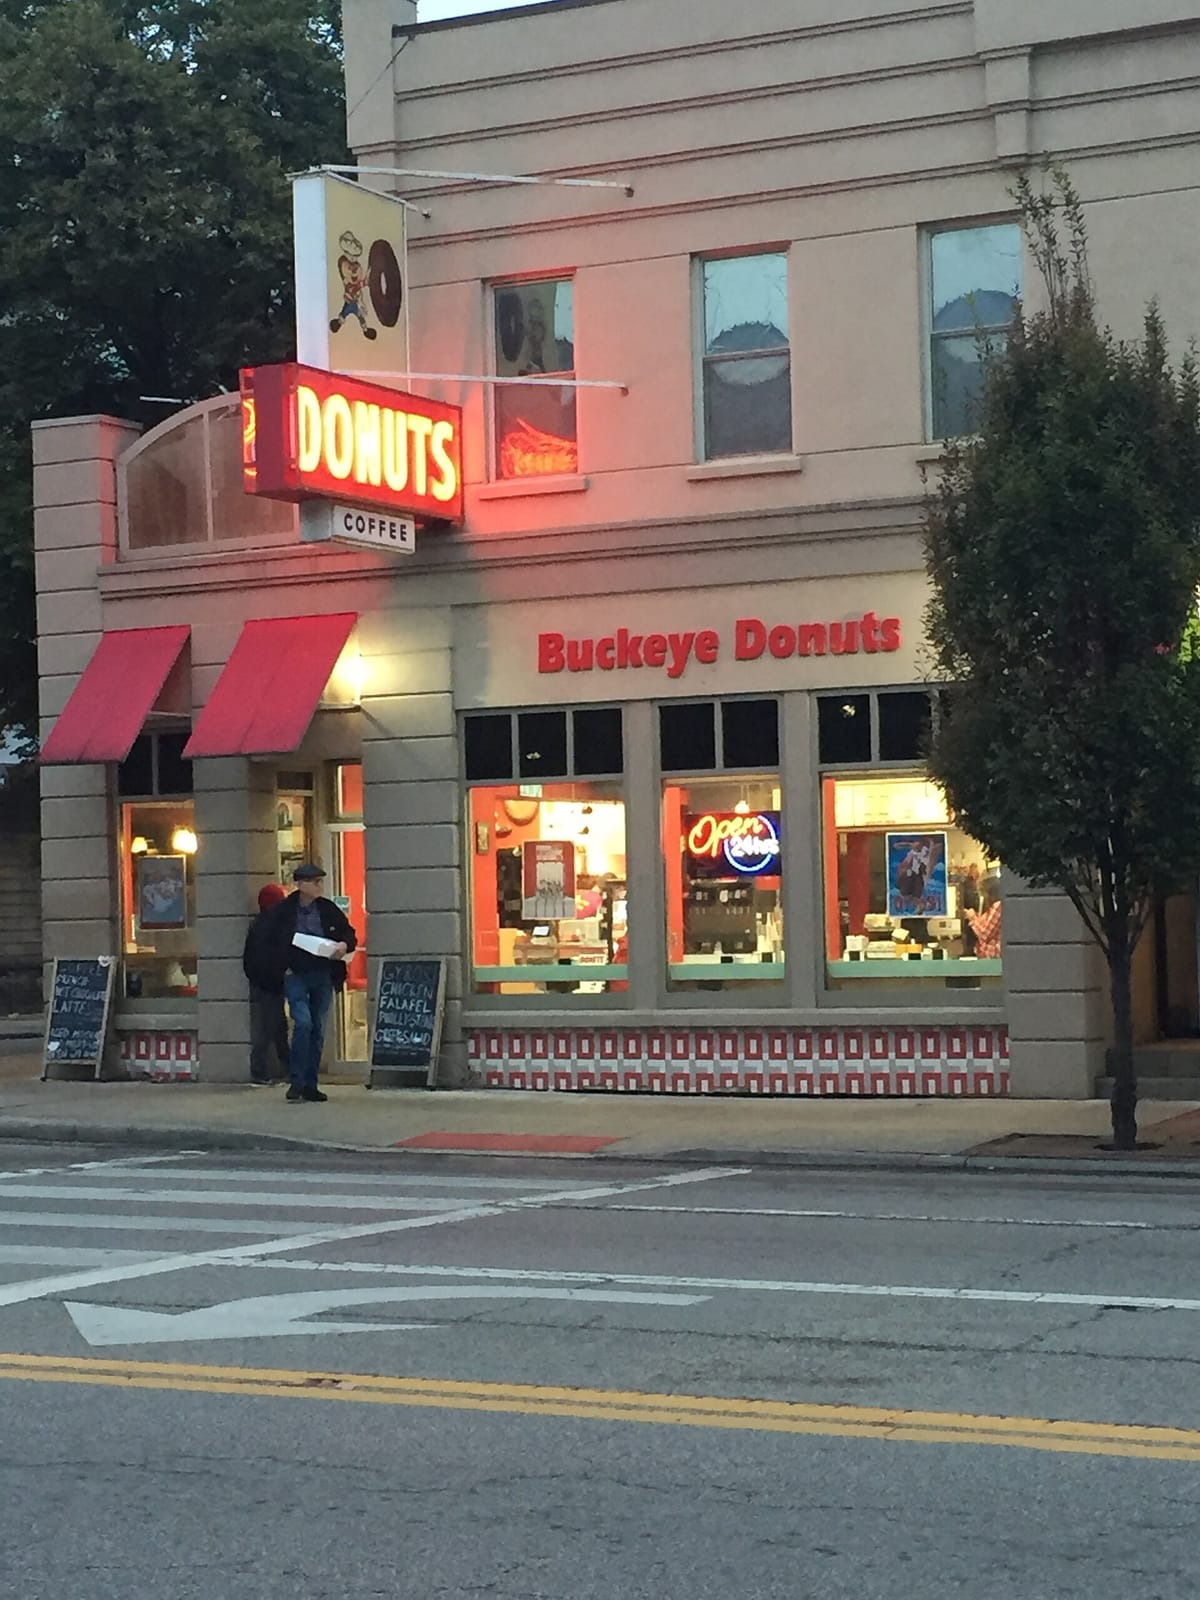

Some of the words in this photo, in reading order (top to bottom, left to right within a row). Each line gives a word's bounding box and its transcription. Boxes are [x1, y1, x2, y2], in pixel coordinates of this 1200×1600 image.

[297, 385, 457, 501] DONUTS
[343, 513, 407, 541] COFFEE
[538, 628, 720, 678] Buckeye
[735, 612, 901, 661] Donuts
[688, 815, 763, 857] Open
[380, 995, 432, 1014] FALAFEL
